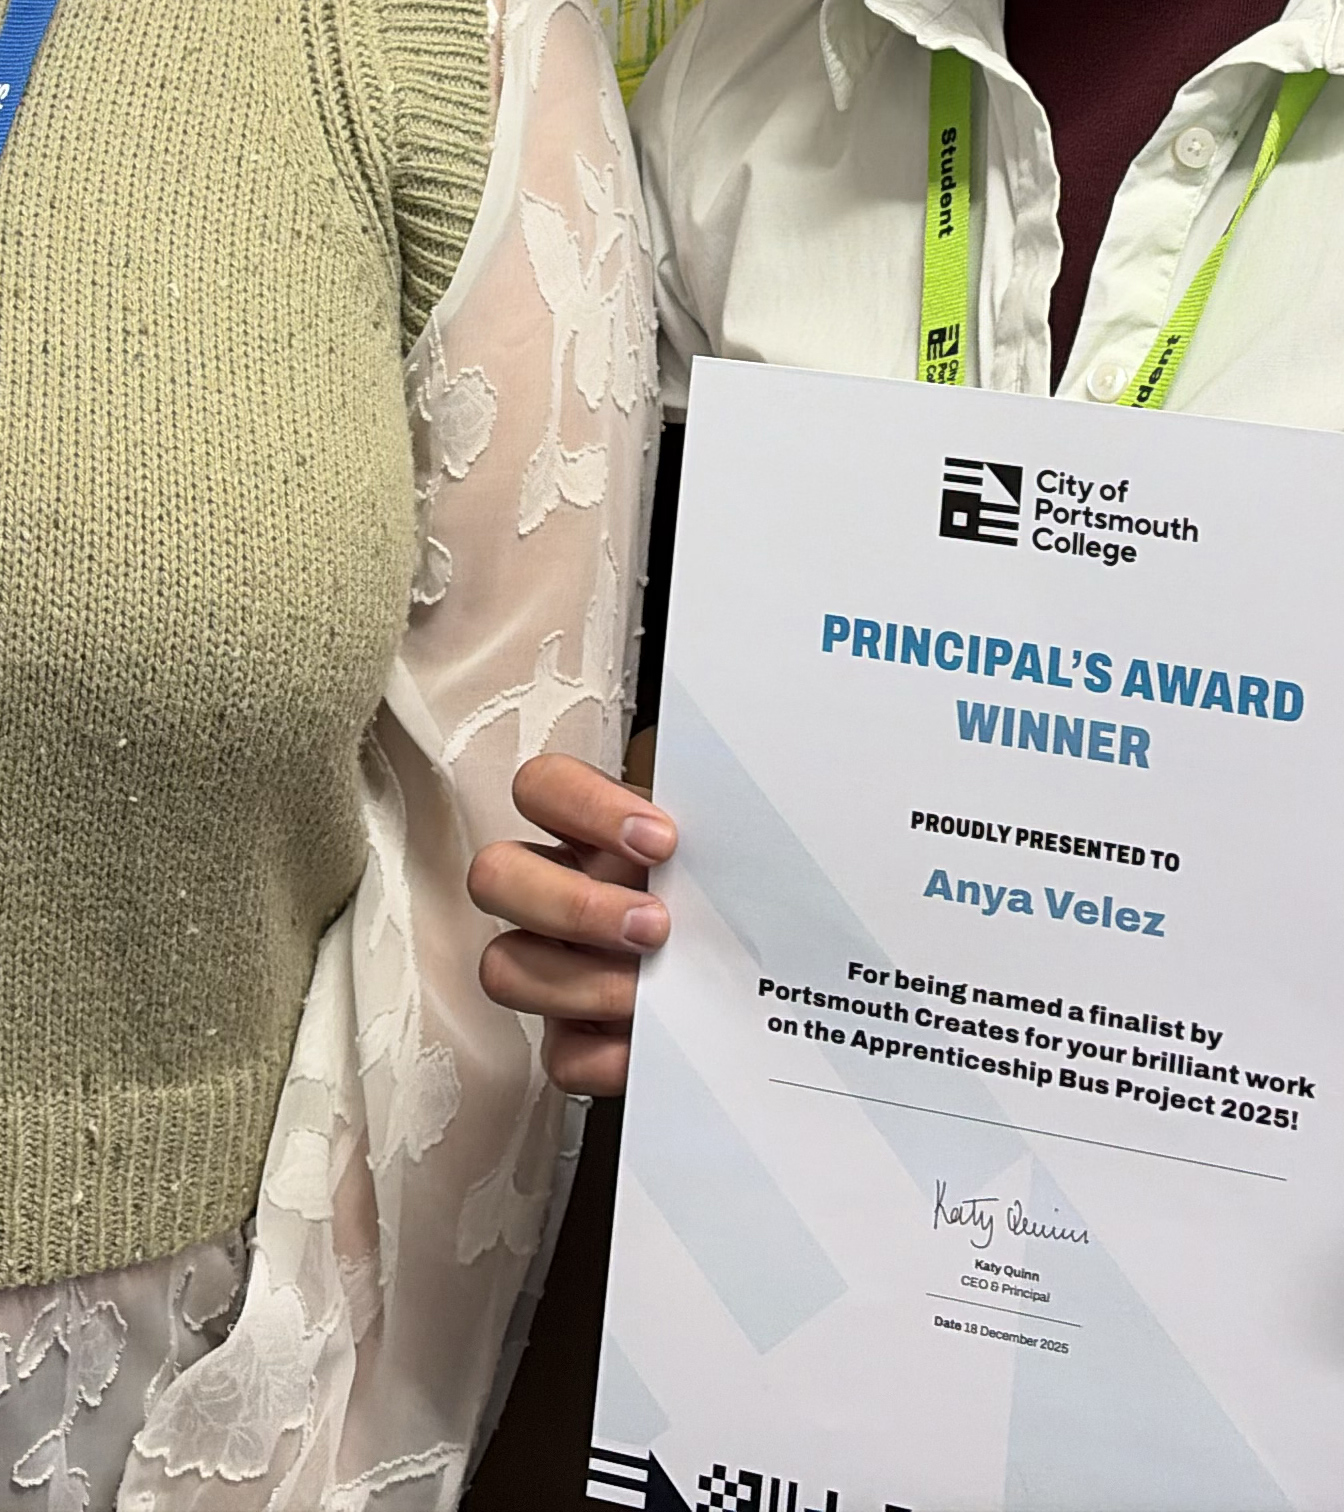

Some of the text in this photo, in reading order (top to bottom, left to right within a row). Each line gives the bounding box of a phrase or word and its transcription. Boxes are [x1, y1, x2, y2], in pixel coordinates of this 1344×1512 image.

[937, 126, 957, 240] Student
[1131, 334, 1182, 408] dent
[1034, 497, 1199, 543] Portsmouth
[1036, 469, 1130, 504] City of
[1031, 526, 1137, 567] College
[821, 613, 1305, 722] PRINCIPAL'S AWARD
[956, 699, 1151, 769] WINNER
[910, 810, 1180, 873] PROUDLY PRESENTED TO
[923, 869, 1165, 937] Anya Velez
[758, 977, 1316, 1099] Portsmouth Creates for your brilliant work
[847, 961, 1223, 1051] For being named a finalist by
[767, 1016, 1299, 1131] on the Apprenticeship Bus Project 2025!
[933, 1179, 999, 1249] Katy
[961, 1275, 1051, 1303] CEO & Principal
[975, 1258, 1040, 1283] Katy Quinn
[934, 1315, 1069, 1354] Date 18 December 2025
